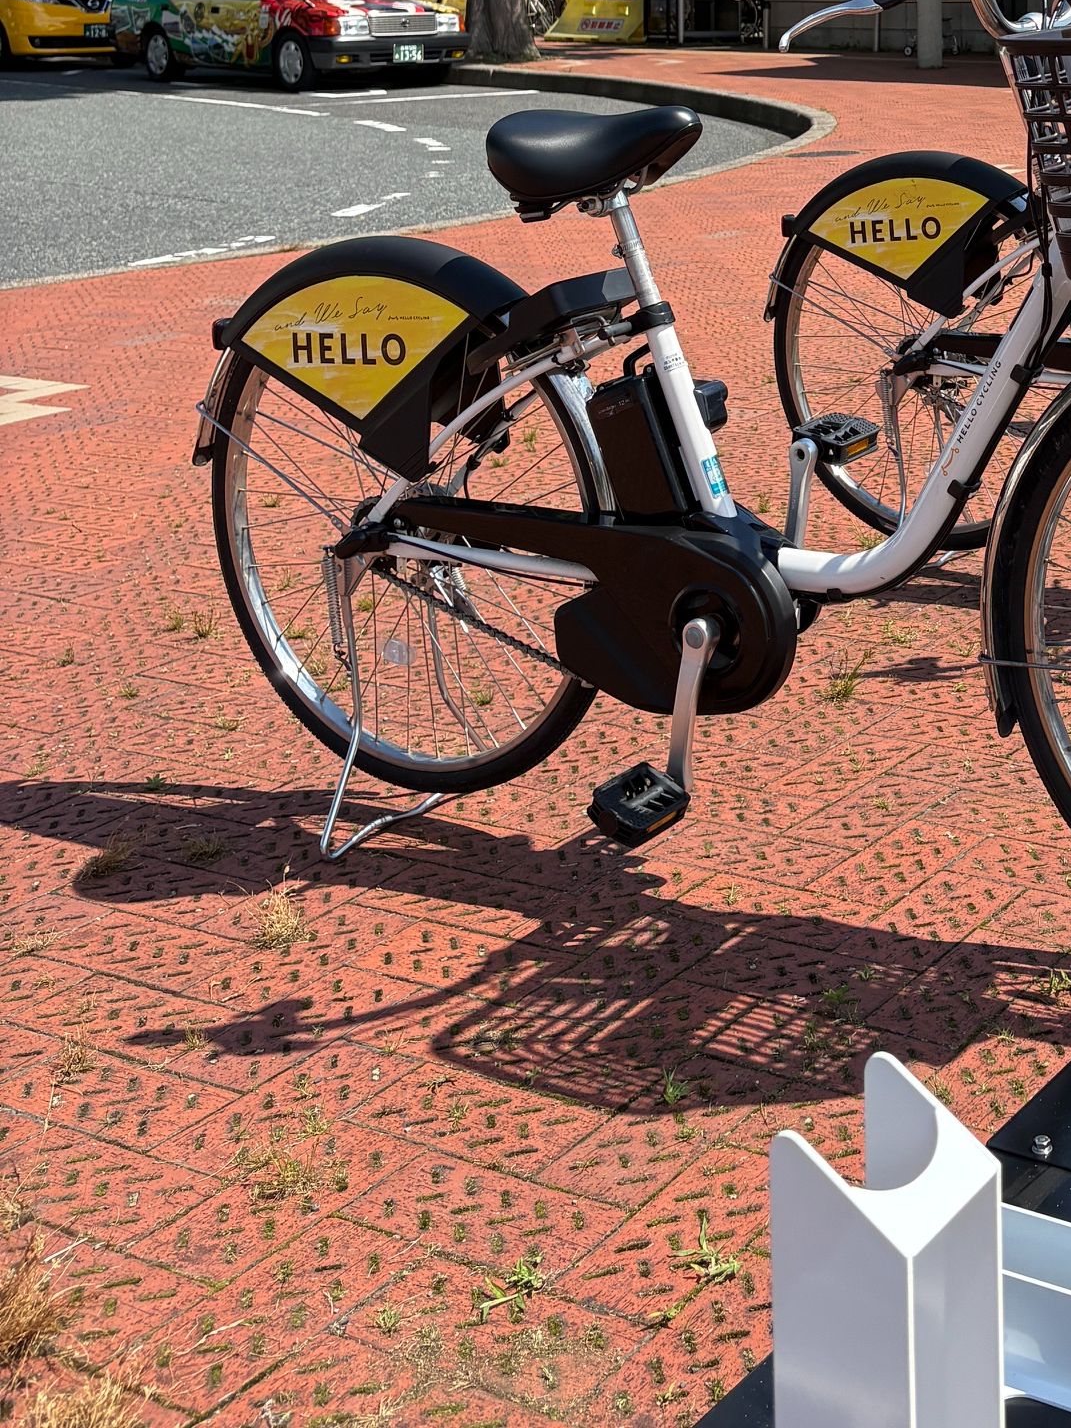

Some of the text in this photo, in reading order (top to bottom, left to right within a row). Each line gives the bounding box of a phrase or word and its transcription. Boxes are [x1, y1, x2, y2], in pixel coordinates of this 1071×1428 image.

[835, 192, 926, 222] and We Say
[849, 216, 942, 244] HELLO
[274, 296, 388, 332] and We Say
[292, 332, 406, 365] HELLO
[956, 360, 1002, 444] HELLO CYCLING
